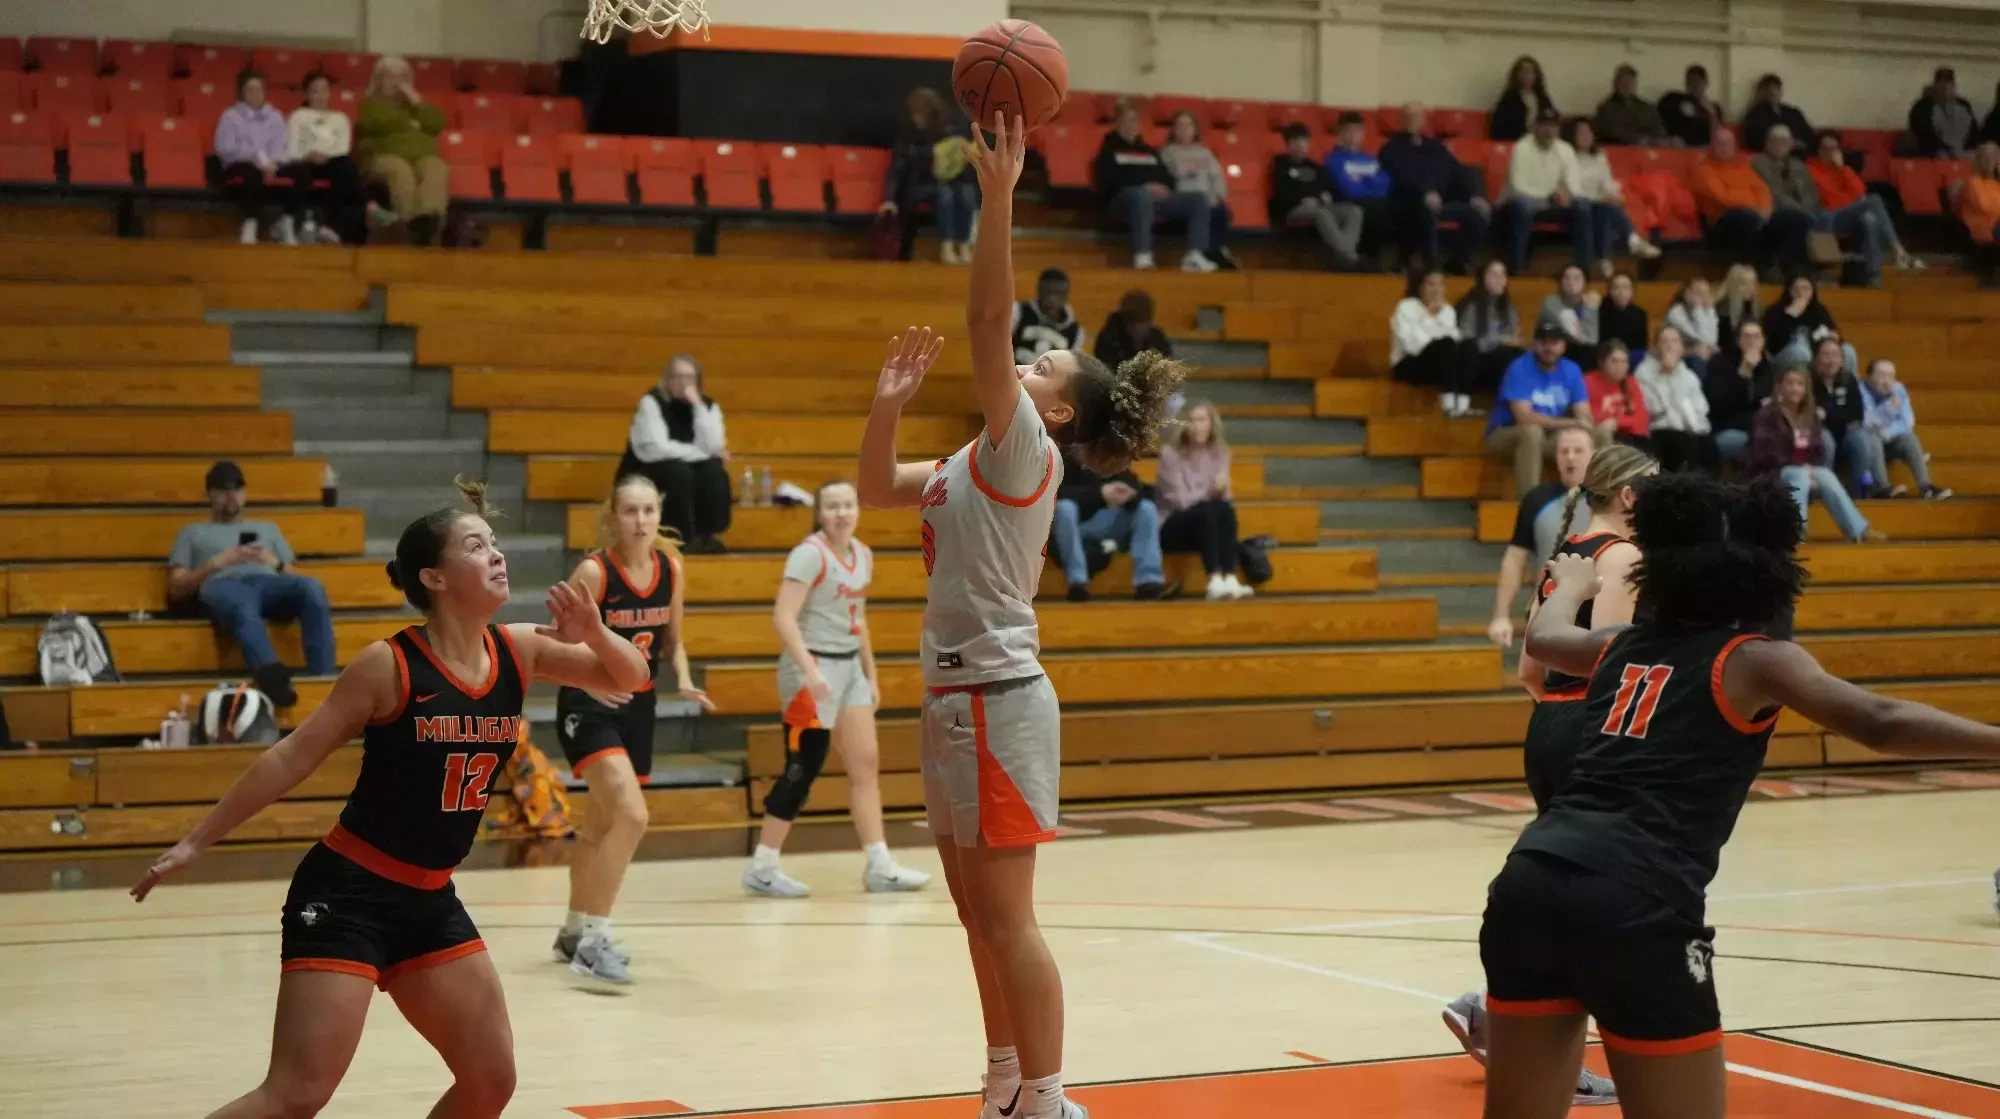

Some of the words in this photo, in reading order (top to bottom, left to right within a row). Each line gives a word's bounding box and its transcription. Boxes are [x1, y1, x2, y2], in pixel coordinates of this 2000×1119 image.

[605, 606, 671, 628] MILLIGA
[1600, 662, 1674, 739] 11
[441, 752, 499, 812] 12
